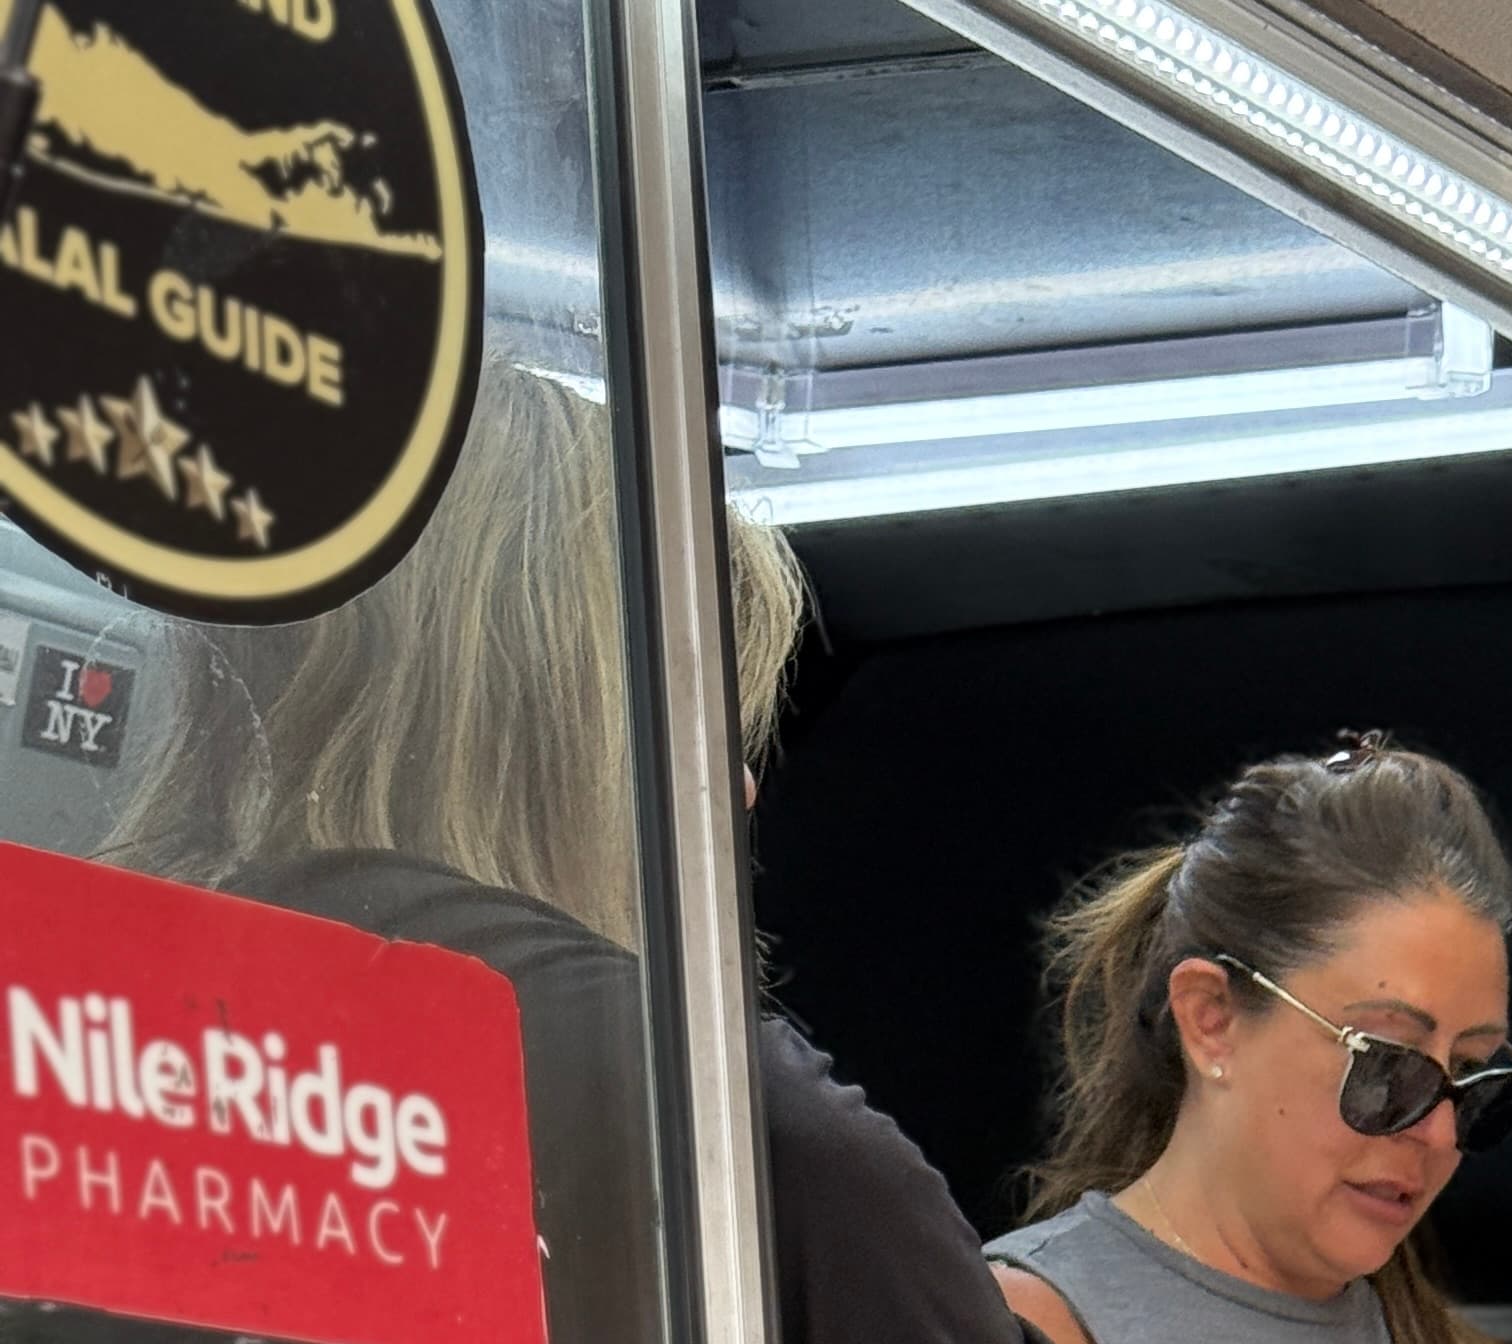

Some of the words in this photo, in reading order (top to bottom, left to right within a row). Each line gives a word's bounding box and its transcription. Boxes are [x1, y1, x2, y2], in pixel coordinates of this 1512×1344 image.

[149, 270, 344, 407] GUIDE
[40, 699, 113, 751] NY
[56, 659, 80, 700] I
[21, 1135, 448, 1269] PHARMACY
